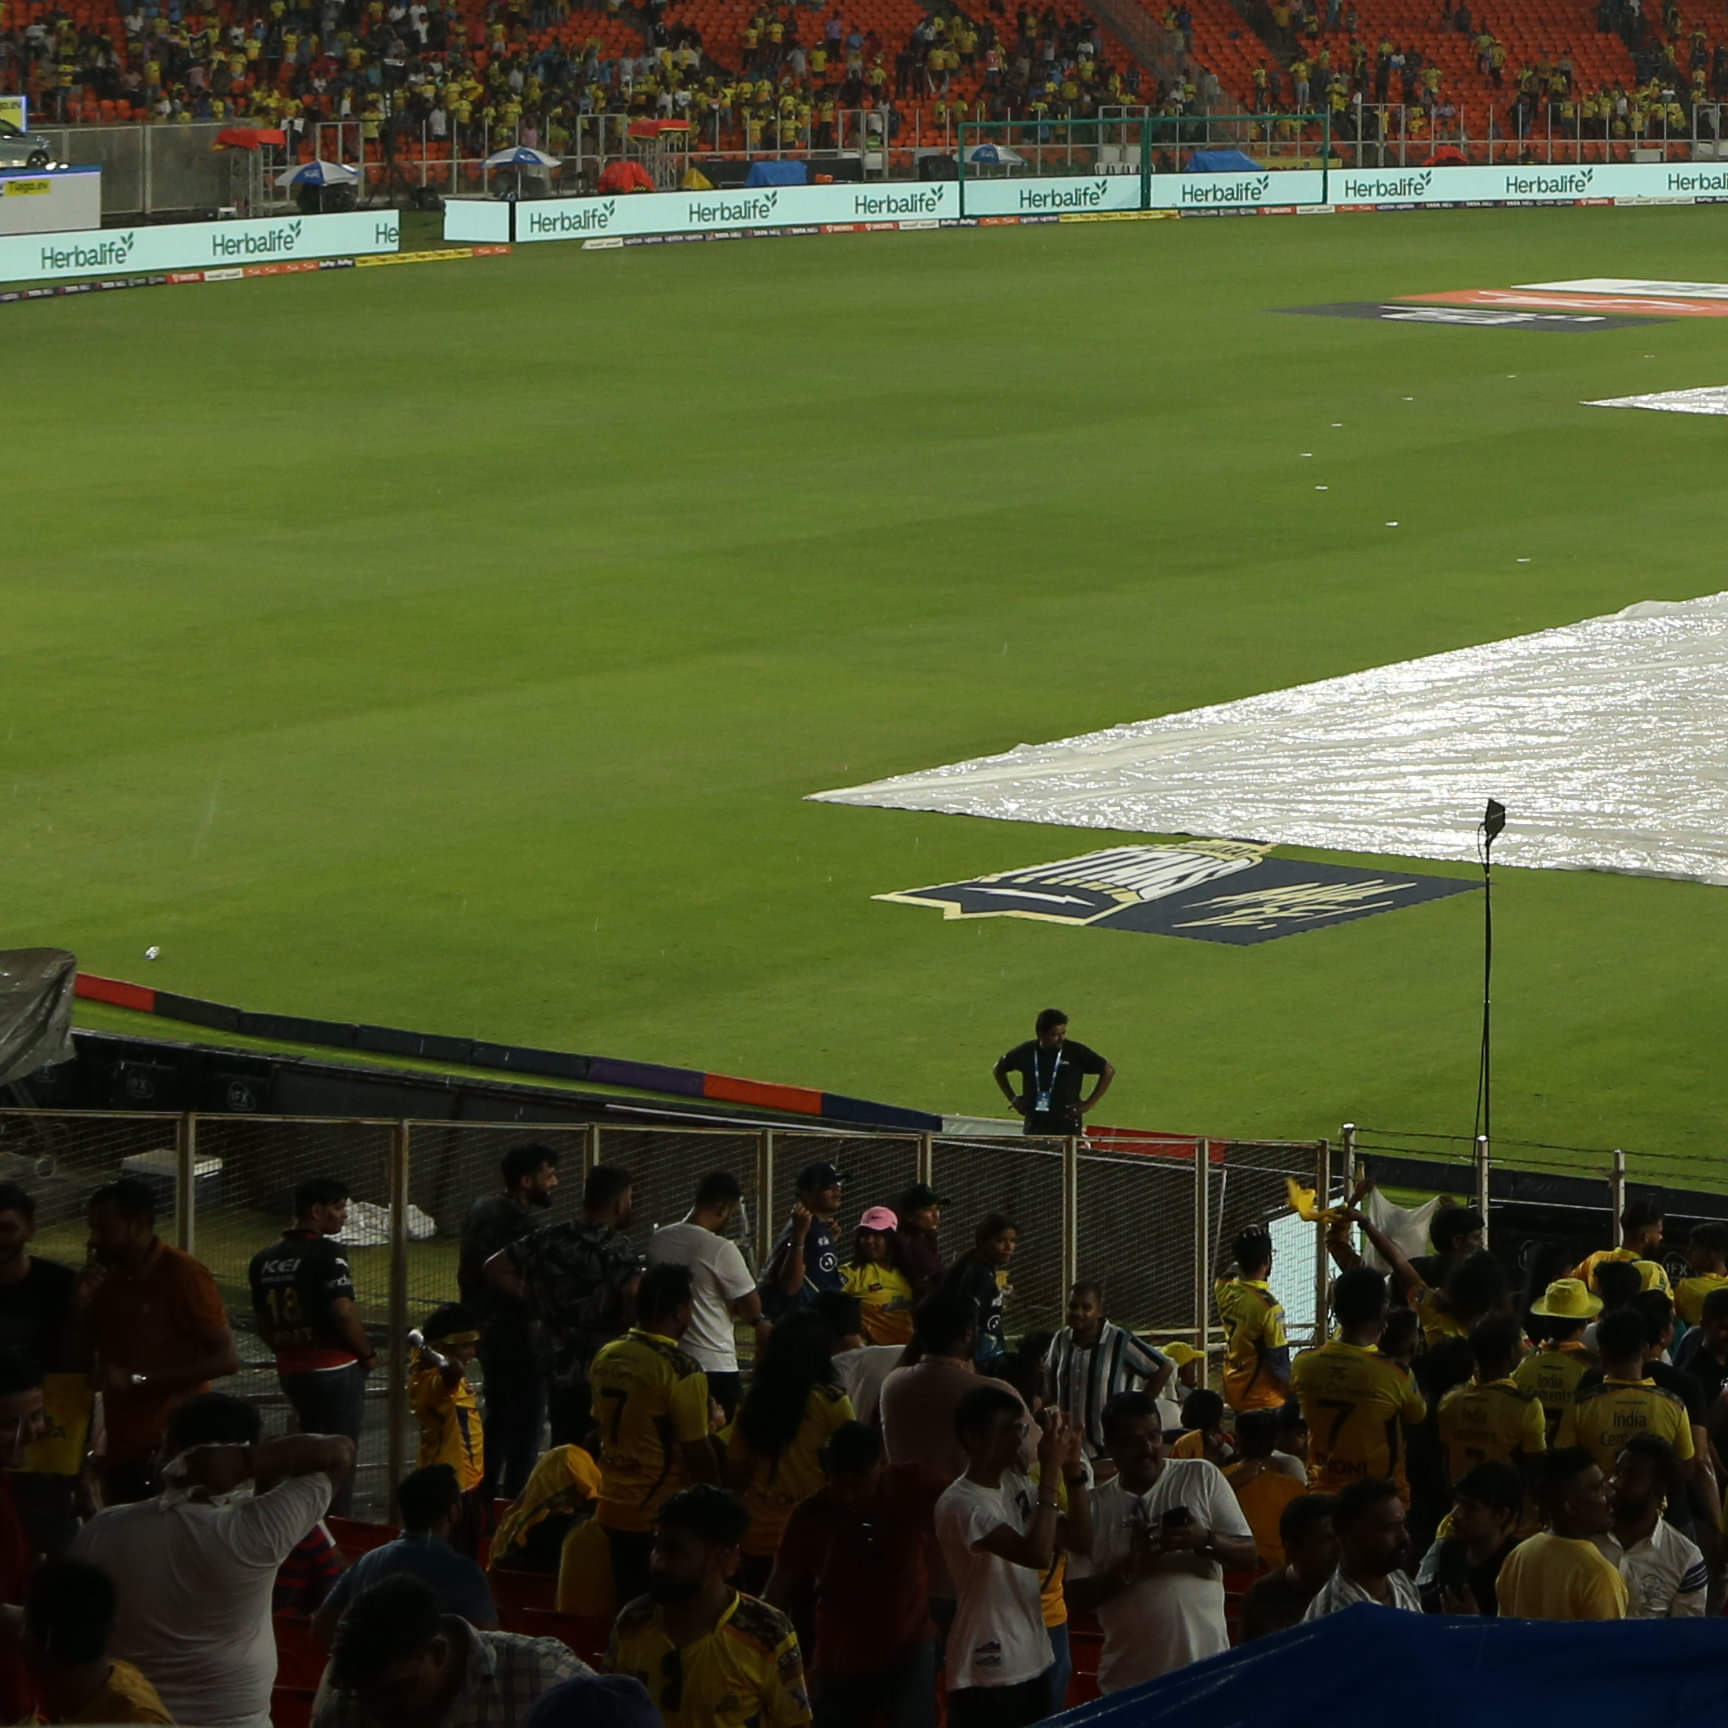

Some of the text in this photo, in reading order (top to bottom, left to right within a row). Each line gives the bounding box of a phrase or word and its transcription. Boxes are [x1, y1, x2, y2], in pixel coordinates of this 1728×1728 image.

[1182, 180, 1267, 203] Herbalife
[1345, 174, 1429, 198] Herbalife
[1506, 172, 1592, 194] Herbalife
[689, 192, 777, 222] Herbalife
[855, 190, 941, 214] Herbalife
[1019, 183, 1105, 212] Herbalife
[530, 206, 614, 233] Herbalife
[212, 223, 299, 256] Herbalife
[42, 239, 133, 269] Herbalife
[262, 1256, 302, 1274] KEI
[1316, 1398, 1356, 1453] 7
[1612, 1408, 1648, 1429] India
